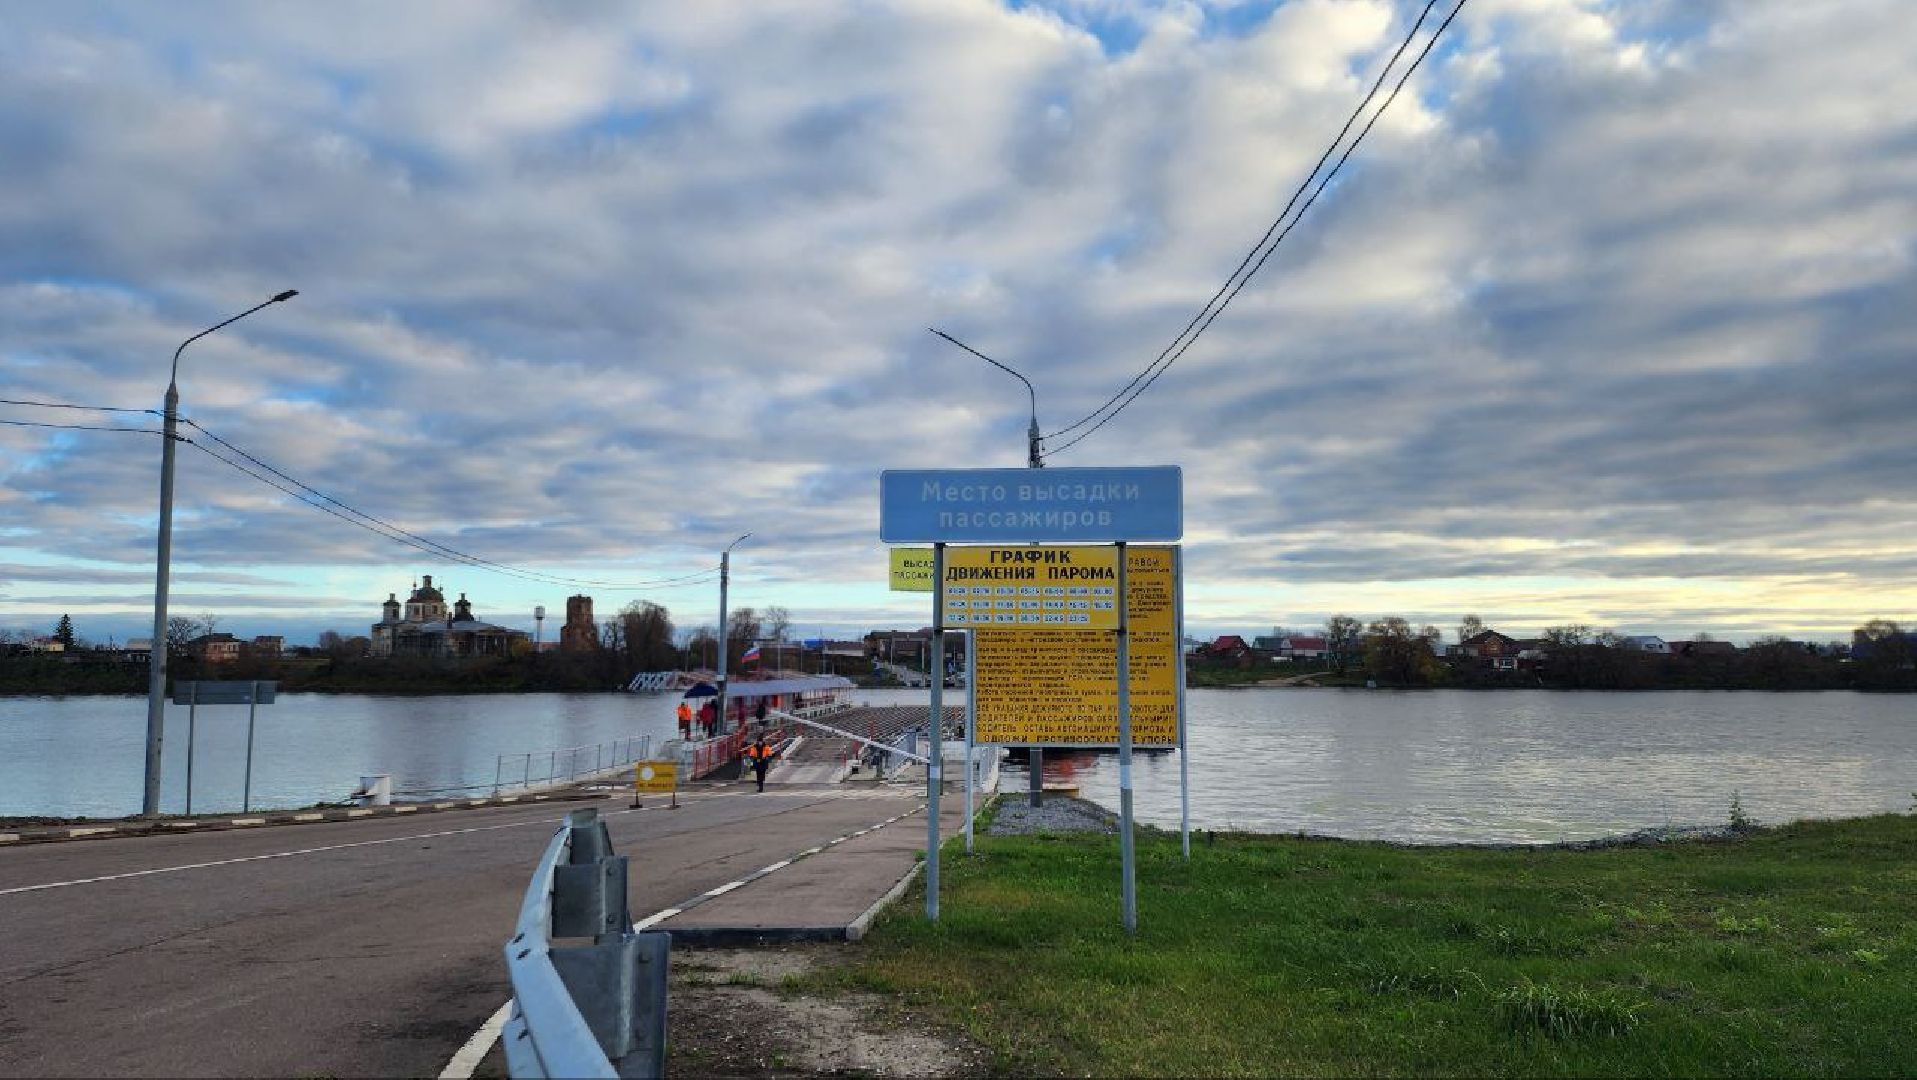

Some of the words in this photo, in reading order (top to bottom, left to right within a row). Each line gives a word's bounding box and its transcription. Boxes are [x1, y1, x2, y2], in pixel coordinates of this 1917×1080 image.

[922, 479, 1006, 502] Место
[1018, 479, 1139, 502] высадки
[939, 508, 1113, 531] пассажиров
[990, 550, 1071, 564] ГРАФИК
[946, 566, 1035, 581] ДВИЖЕНИЯ
[1048, 566, 1115, 580] ПАРОМА
